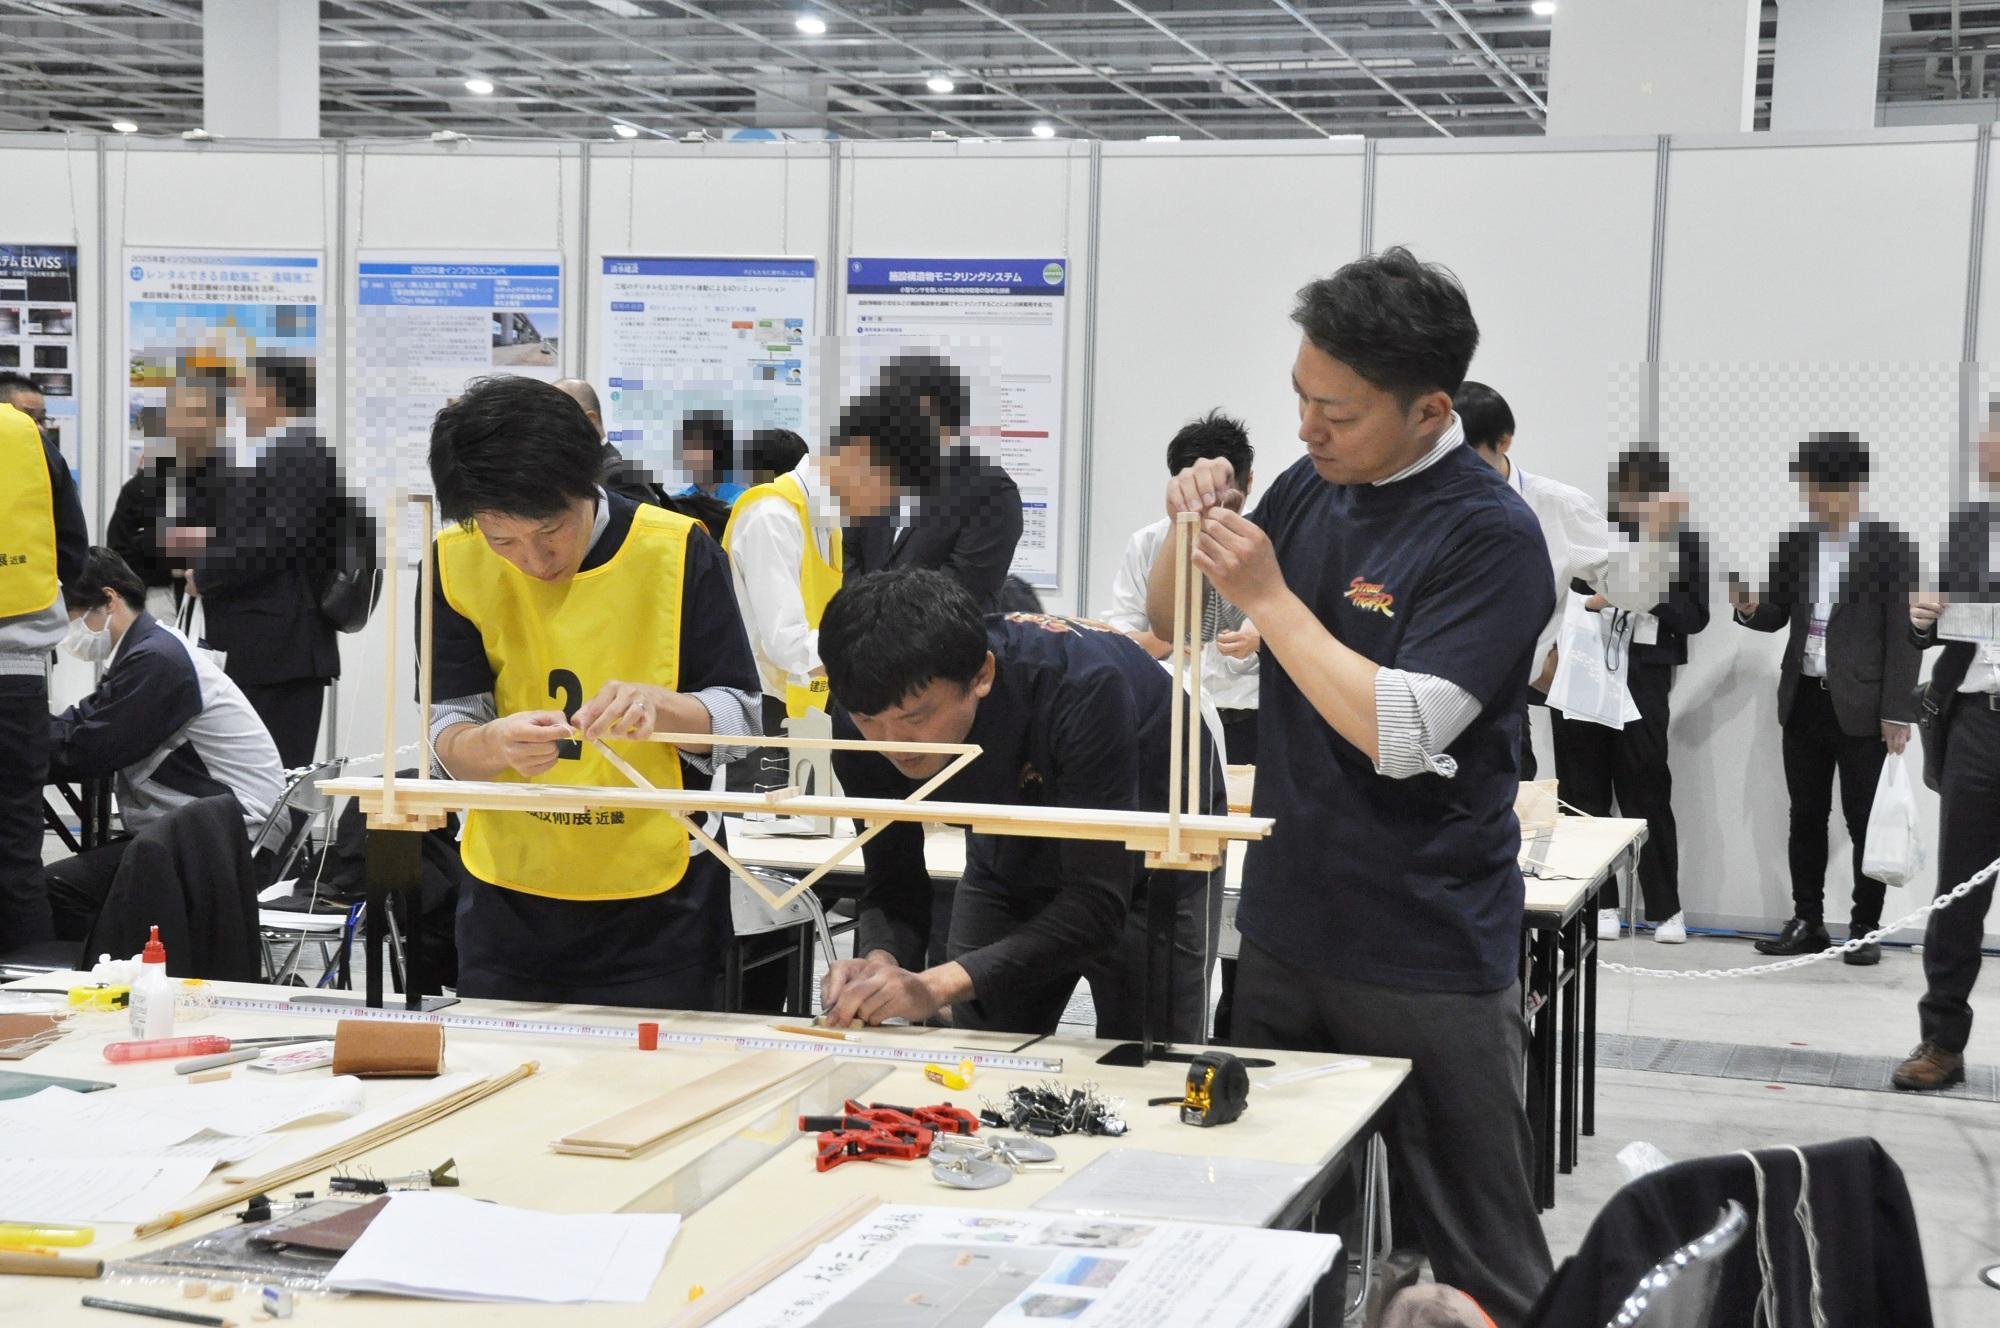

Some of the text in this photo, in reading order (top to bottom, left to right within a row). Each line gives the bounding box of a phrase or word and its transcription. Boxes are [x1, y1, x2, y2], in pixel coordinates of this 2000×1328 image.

[0, 256, 62, 269] テム ELVISS
[888, 271, 1023, 283] 施設構造物モニタリングシステム
[548, 668, 583, 761] 2
